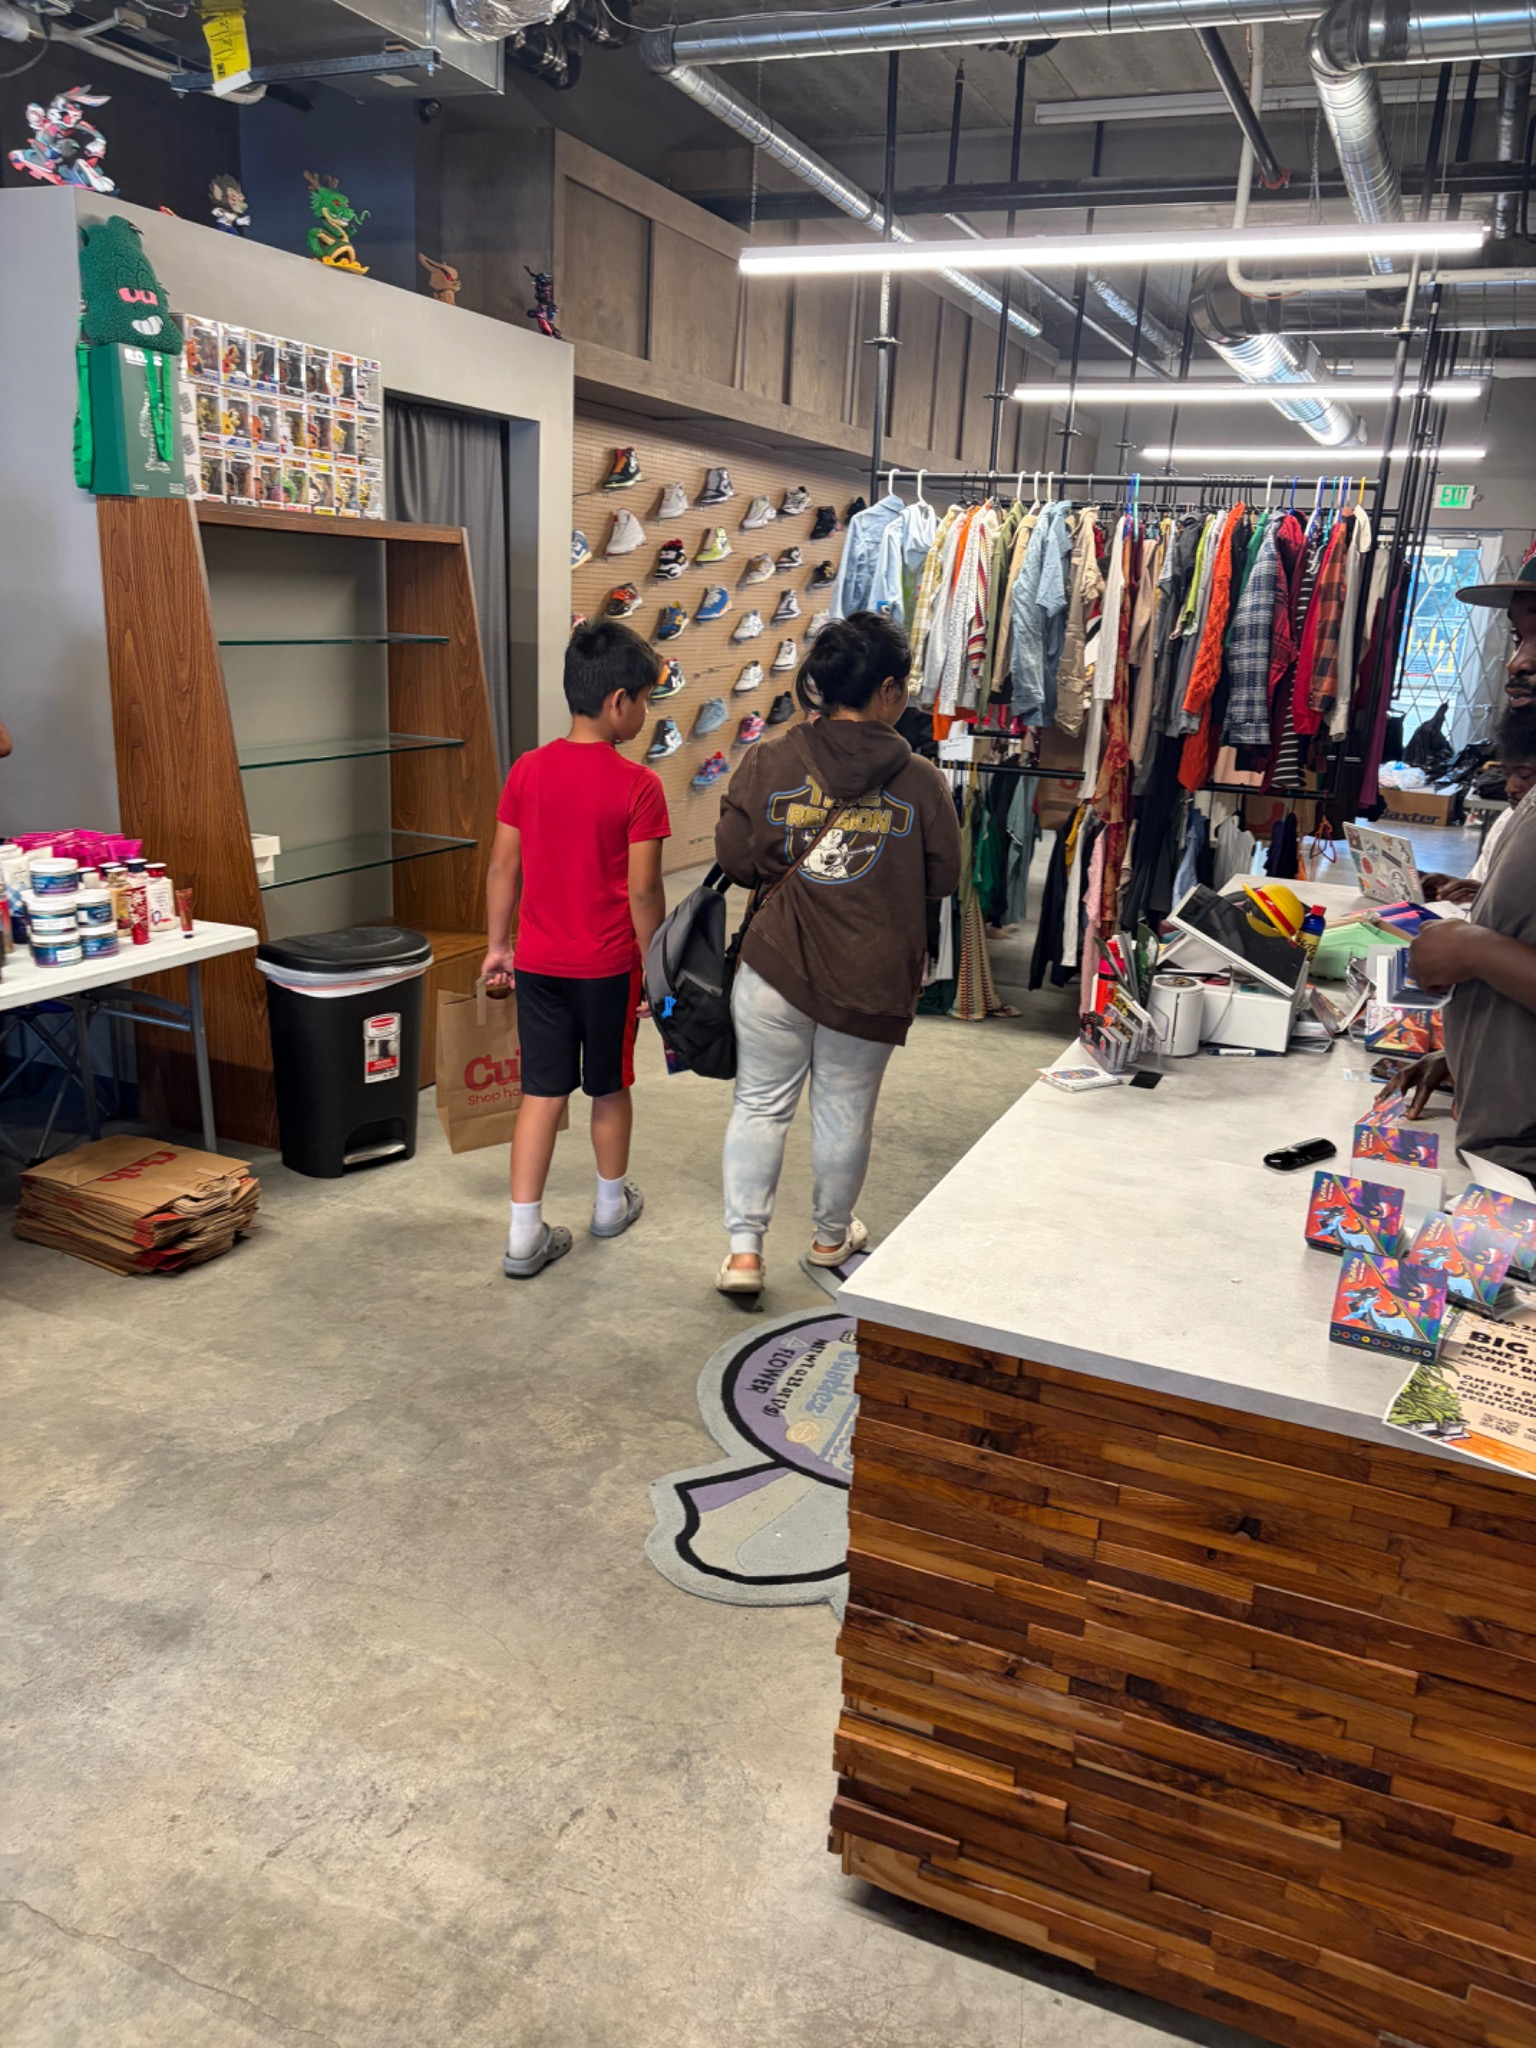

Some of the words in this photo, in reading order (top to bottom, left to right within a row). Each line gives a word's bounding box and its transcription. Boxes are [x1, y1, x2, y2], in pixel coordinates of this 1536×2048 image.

[1440, 486, 1470, 507] EXIT
[786, 803, 893, 834] RELGION
[464, 1047, 521, 1092] Cu
[468, 1092, 501, 1106] Shop
[809, 1337, 831, 1354] NET
[1469, 1331, 1529, 1354] BIG
[746, 1348, 796, 1395] FLOWER
